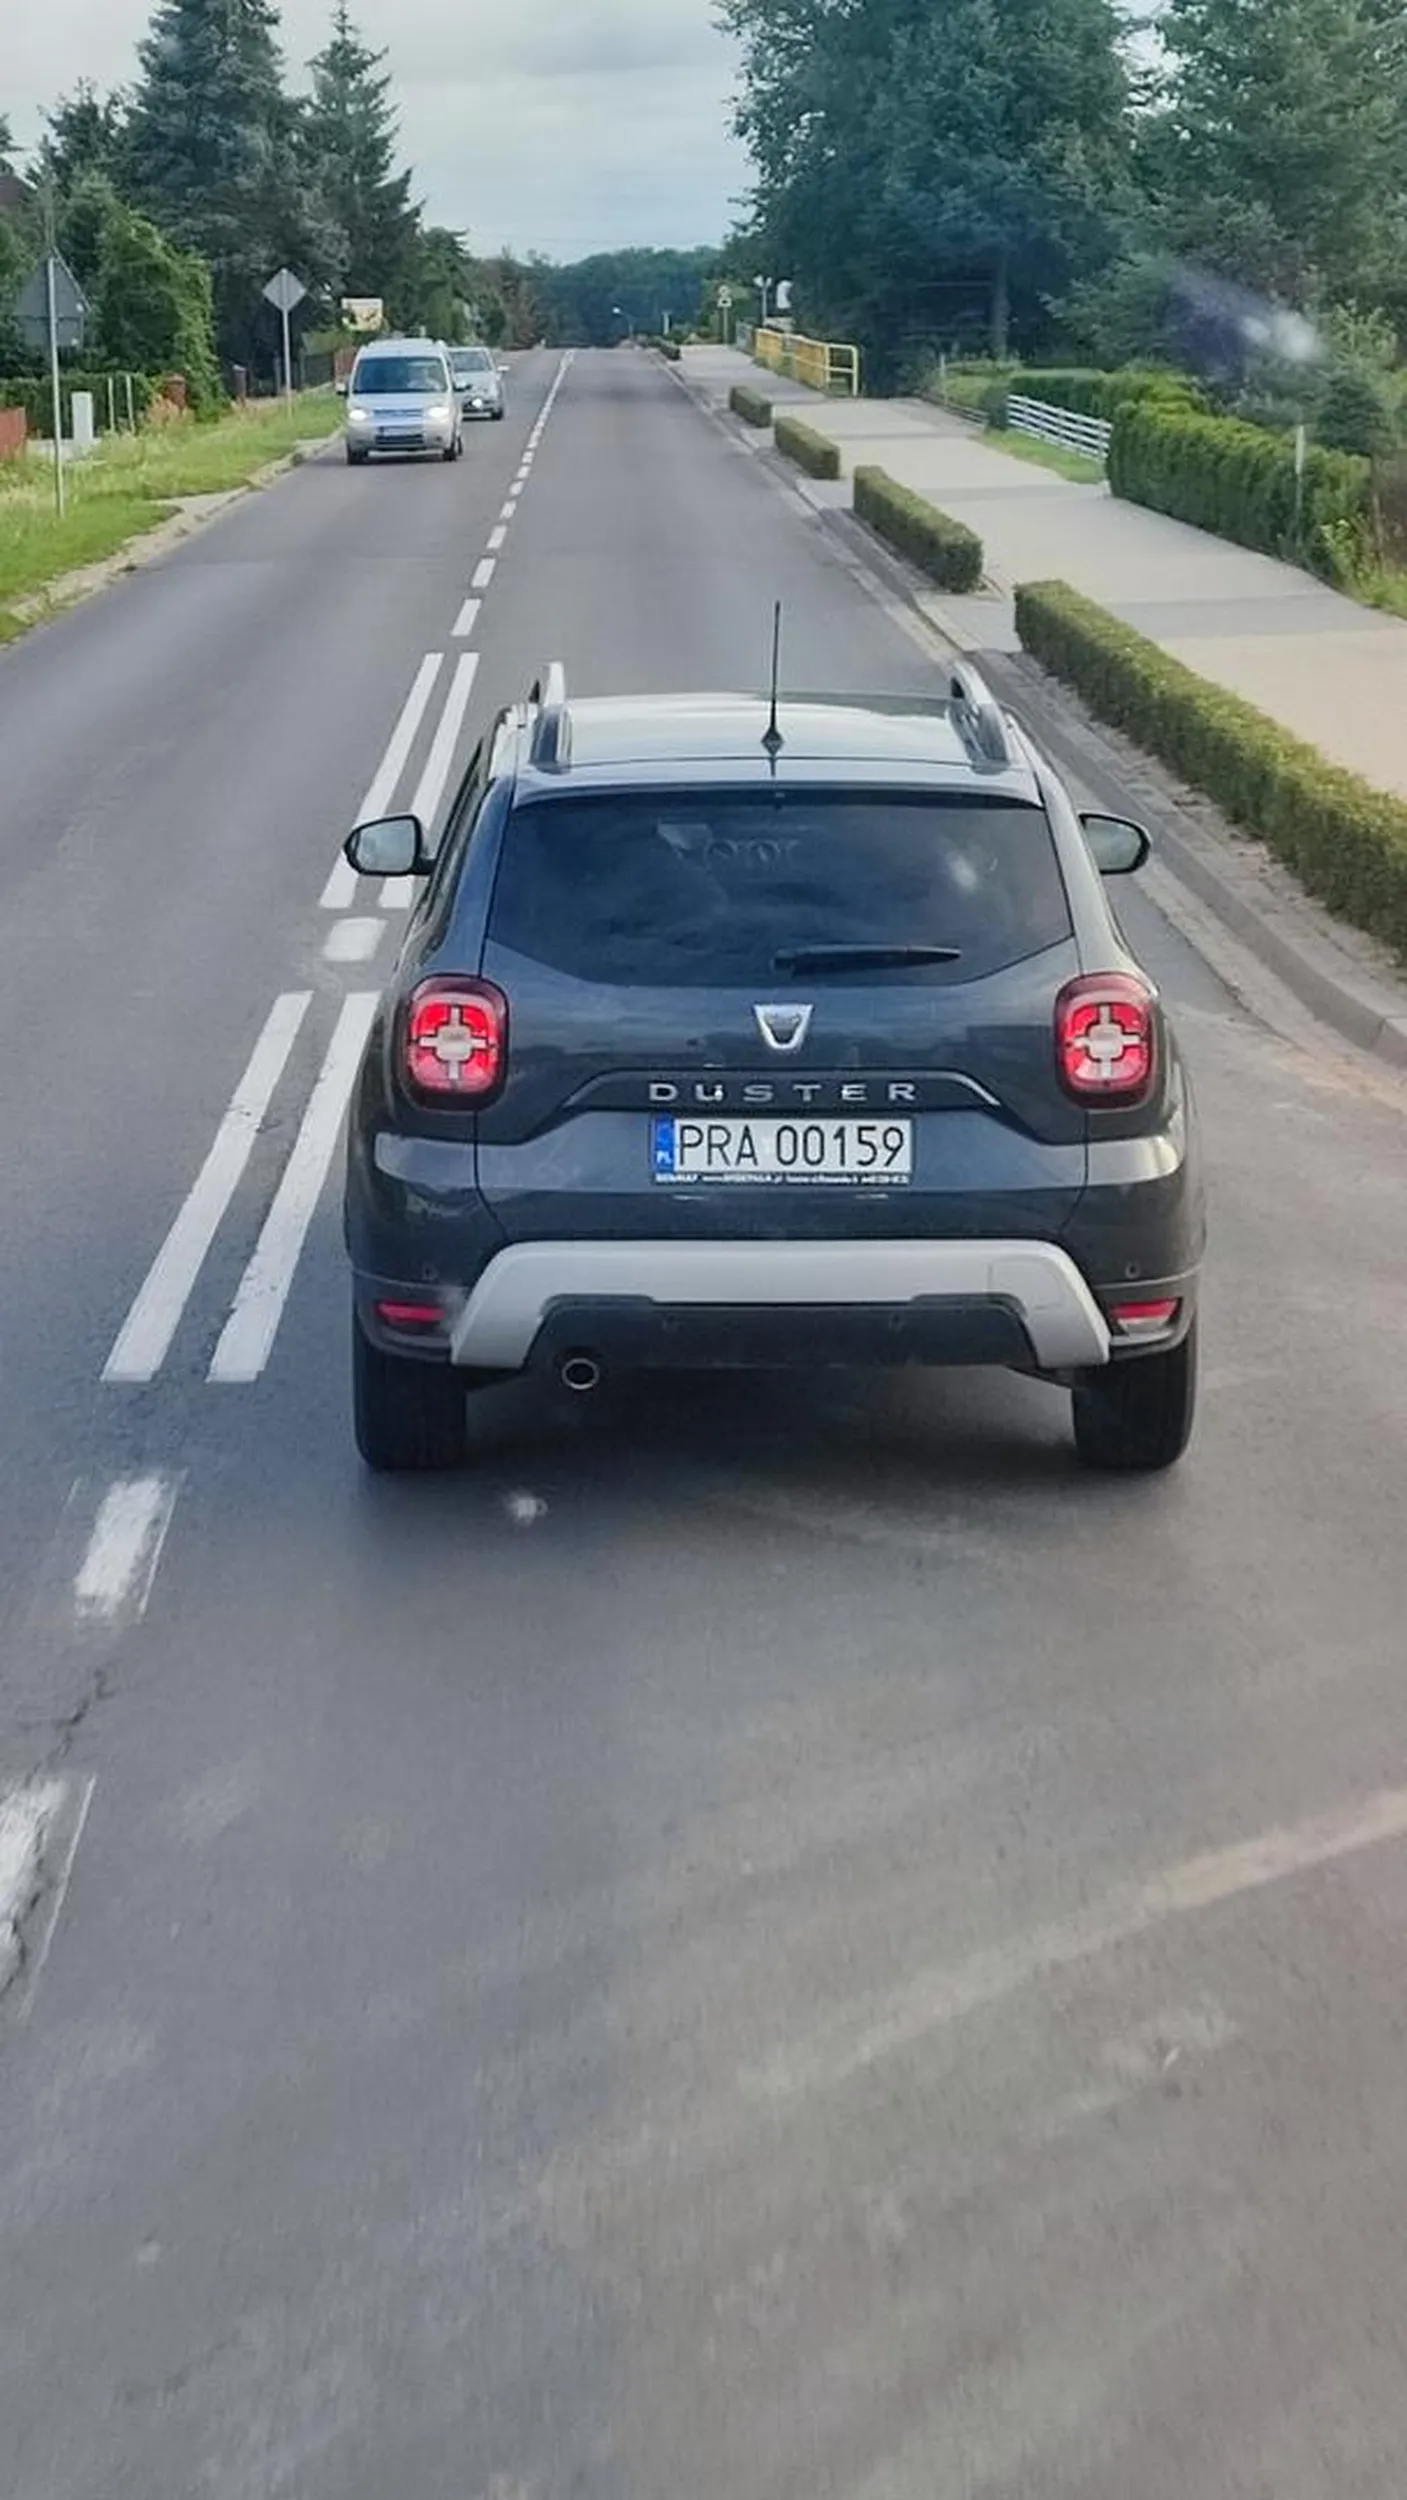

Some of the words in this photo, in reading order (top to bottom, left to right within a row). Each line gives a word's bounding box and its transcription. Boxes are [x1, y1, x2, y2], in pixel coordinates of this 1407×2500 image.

[649, 1083, 916, 1101] DUSTER
[679, 1125, 758, 1166] PRA
[776, 1125, 905, 1167] 00159
